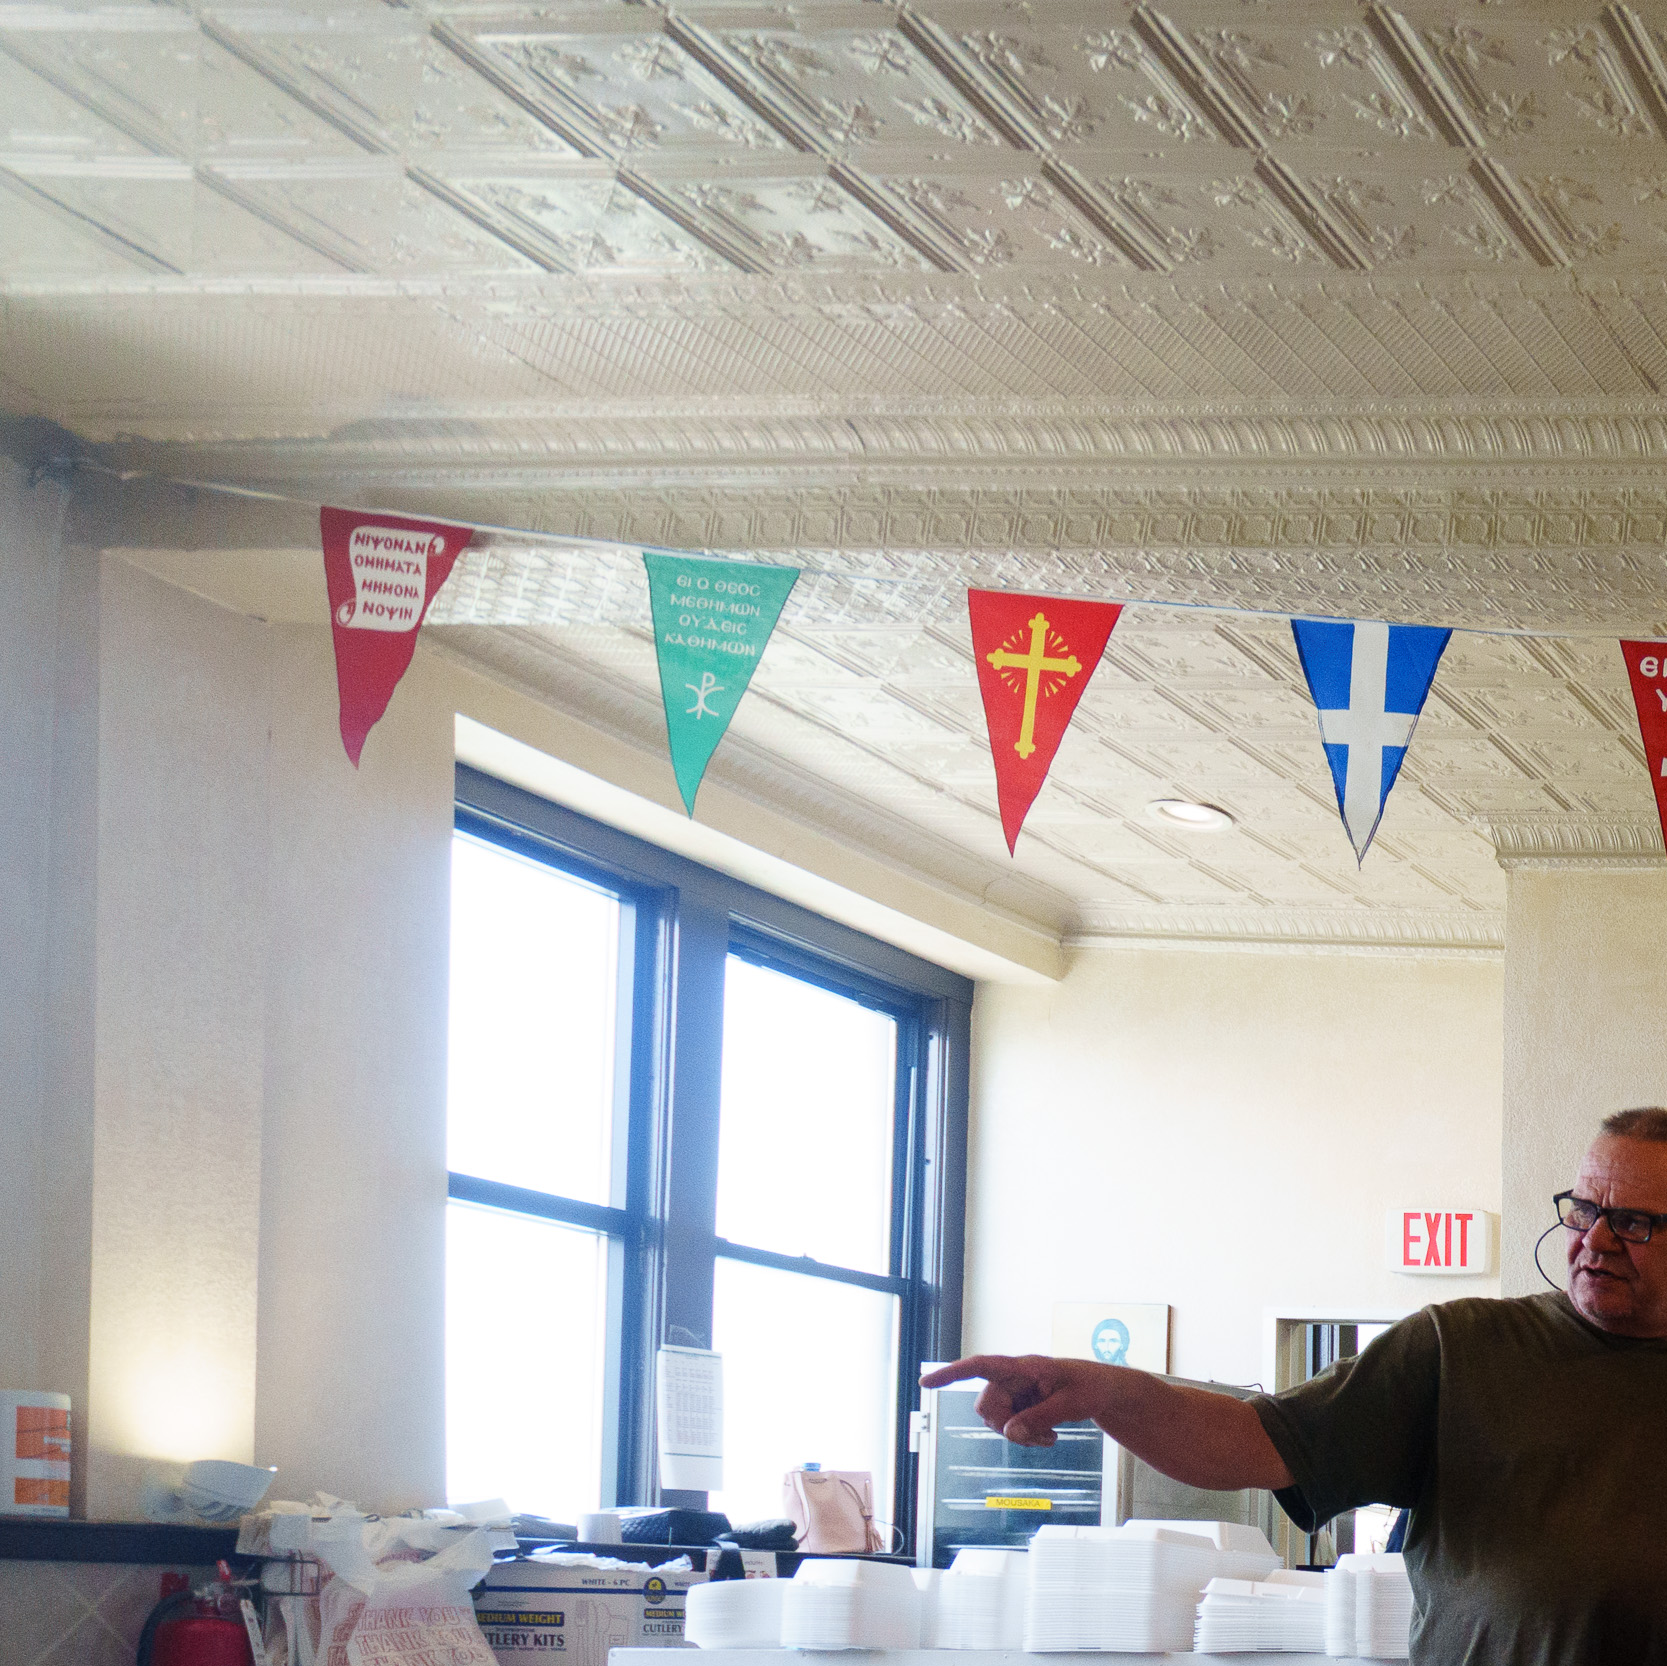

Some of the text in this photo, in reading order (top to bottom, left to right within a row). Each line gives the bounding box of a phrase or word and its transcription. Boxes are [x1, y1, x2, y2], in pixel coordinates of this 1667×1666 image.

[1403, 1212, 1473, 1267] EXIT
[518, 1612, 562, 1624] WEIGHT
[485, 1633, 564, 1647] TLERY KITS
